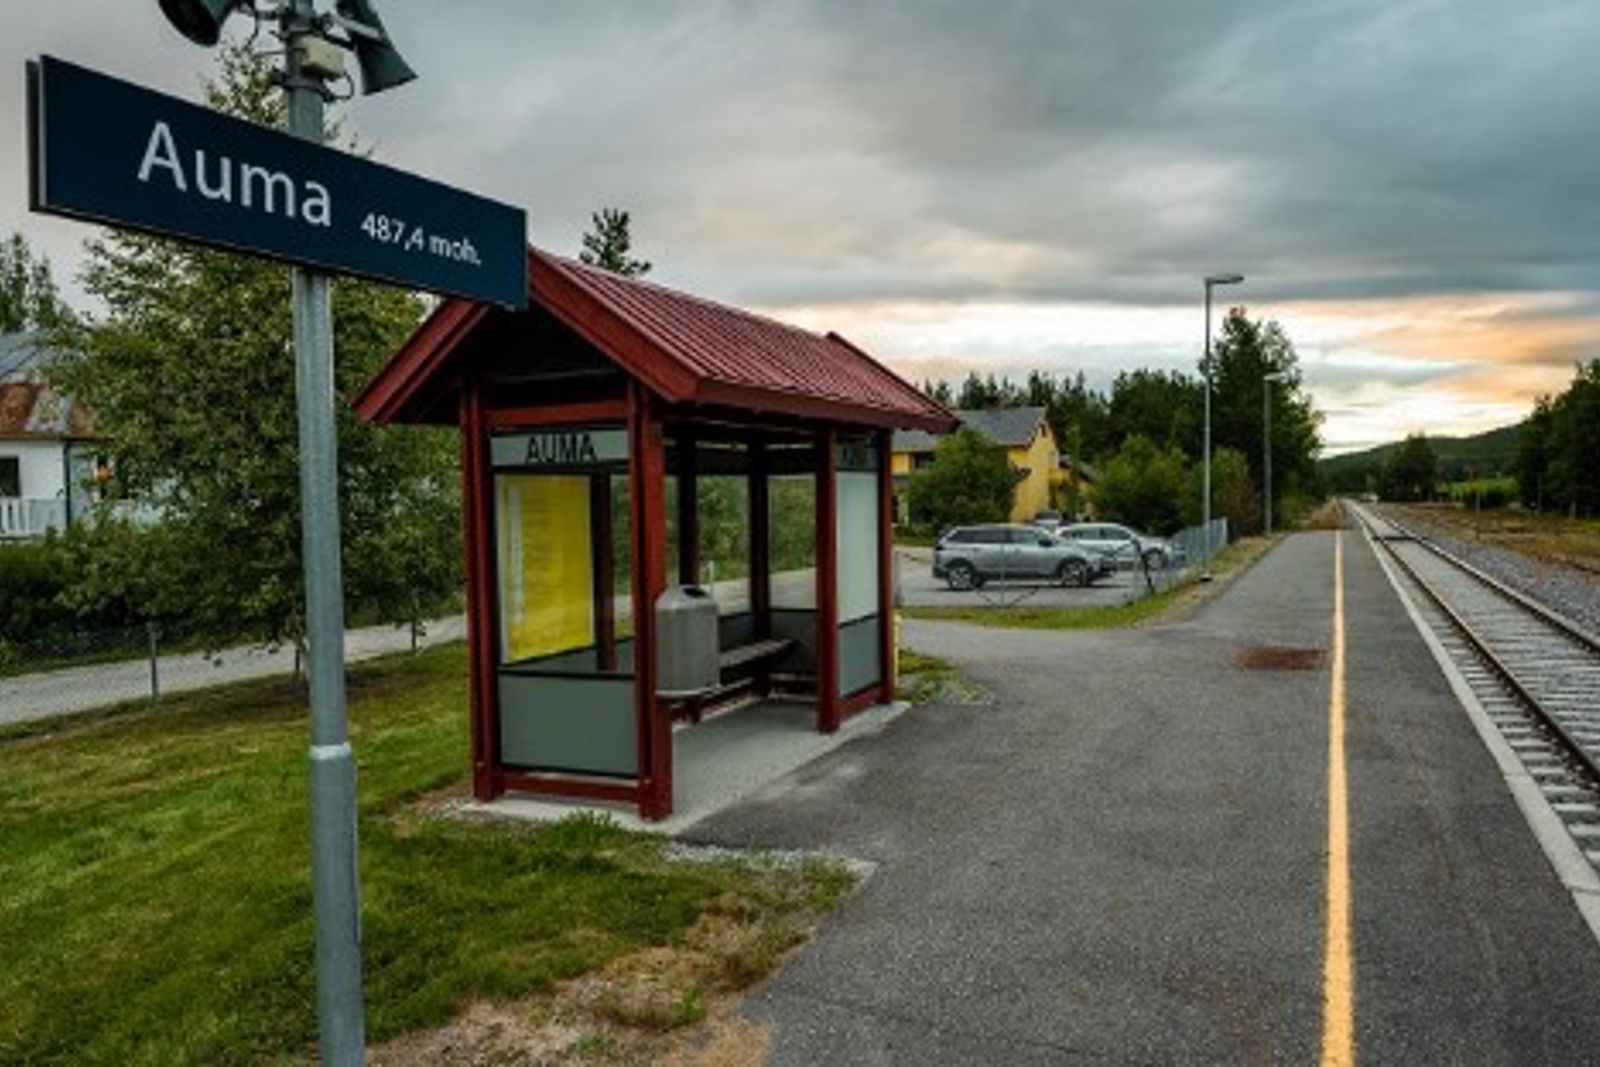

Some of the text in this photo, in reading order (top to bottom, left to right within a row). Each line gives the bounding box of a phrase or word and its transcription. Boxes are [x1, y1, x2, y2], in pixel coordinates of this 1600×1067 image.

[138, 121, 331, 227] Auma
[360, 213, 424, 251] 487,4
[525, 433, 597, 463] AUMA
